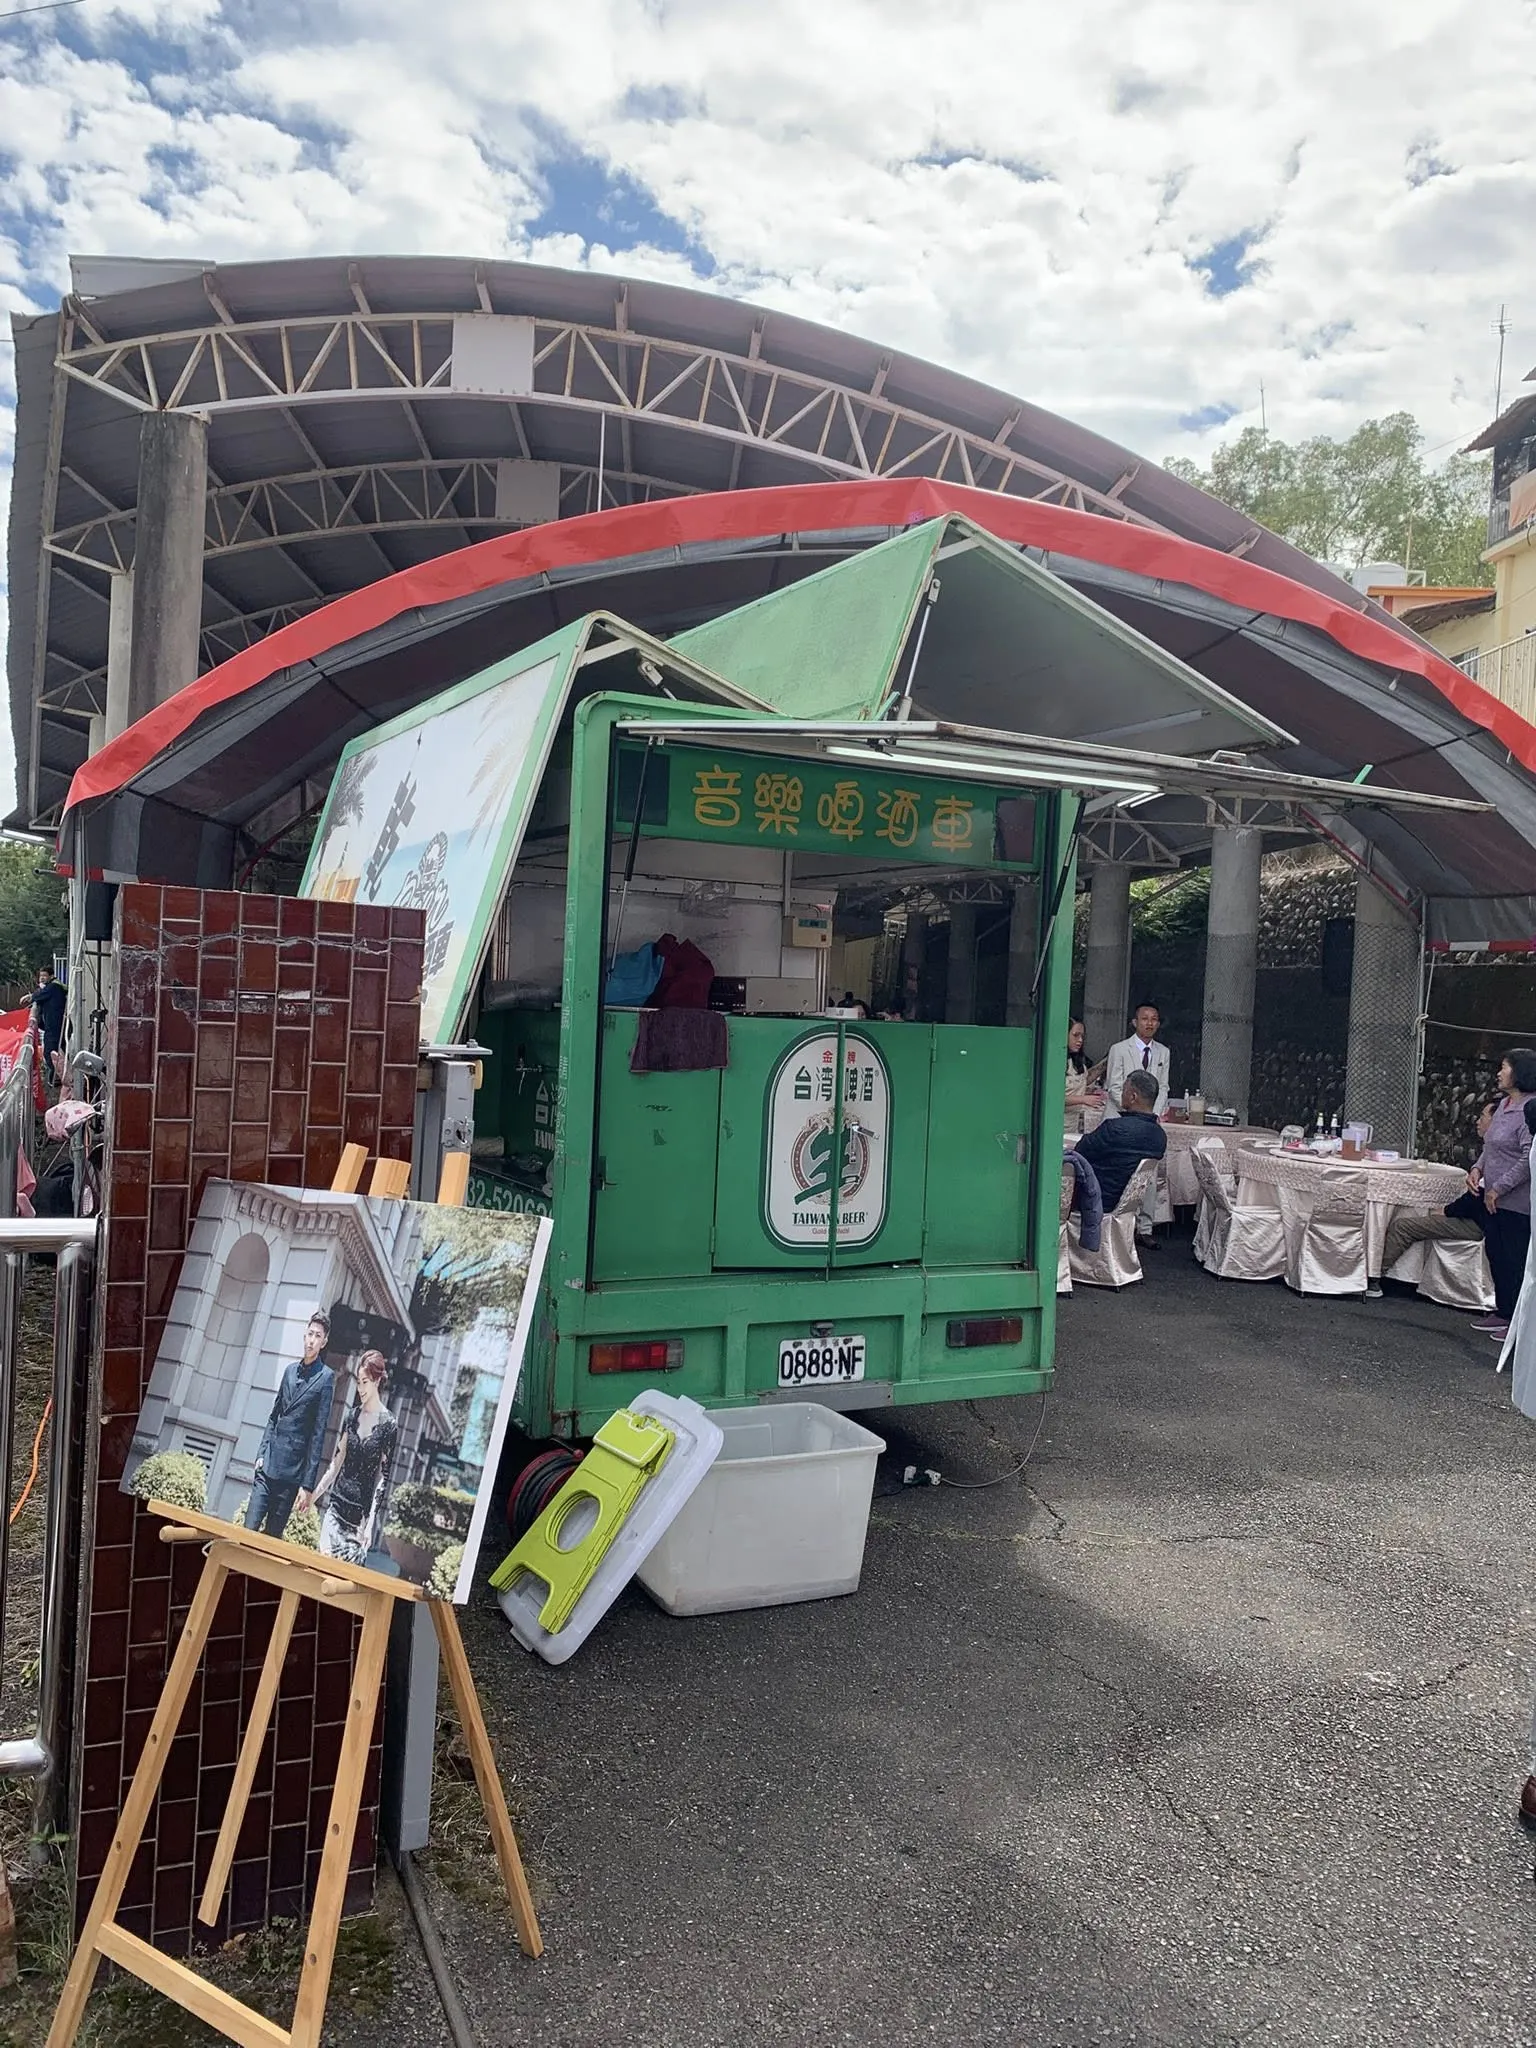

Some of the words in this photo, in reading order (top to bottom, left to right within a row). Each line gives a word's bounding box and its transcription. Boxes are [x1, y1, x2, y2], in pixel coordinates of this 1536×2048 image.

[691, 764, 974, 852] 音樂啤酒車
[822, 1050, 857, 1065] 金牌
[794, 1065, 874, 1102] 台灣啤酒
[842, 1212, 866, 1224] BEER
[811, 1227, 827, 1235] Gold
